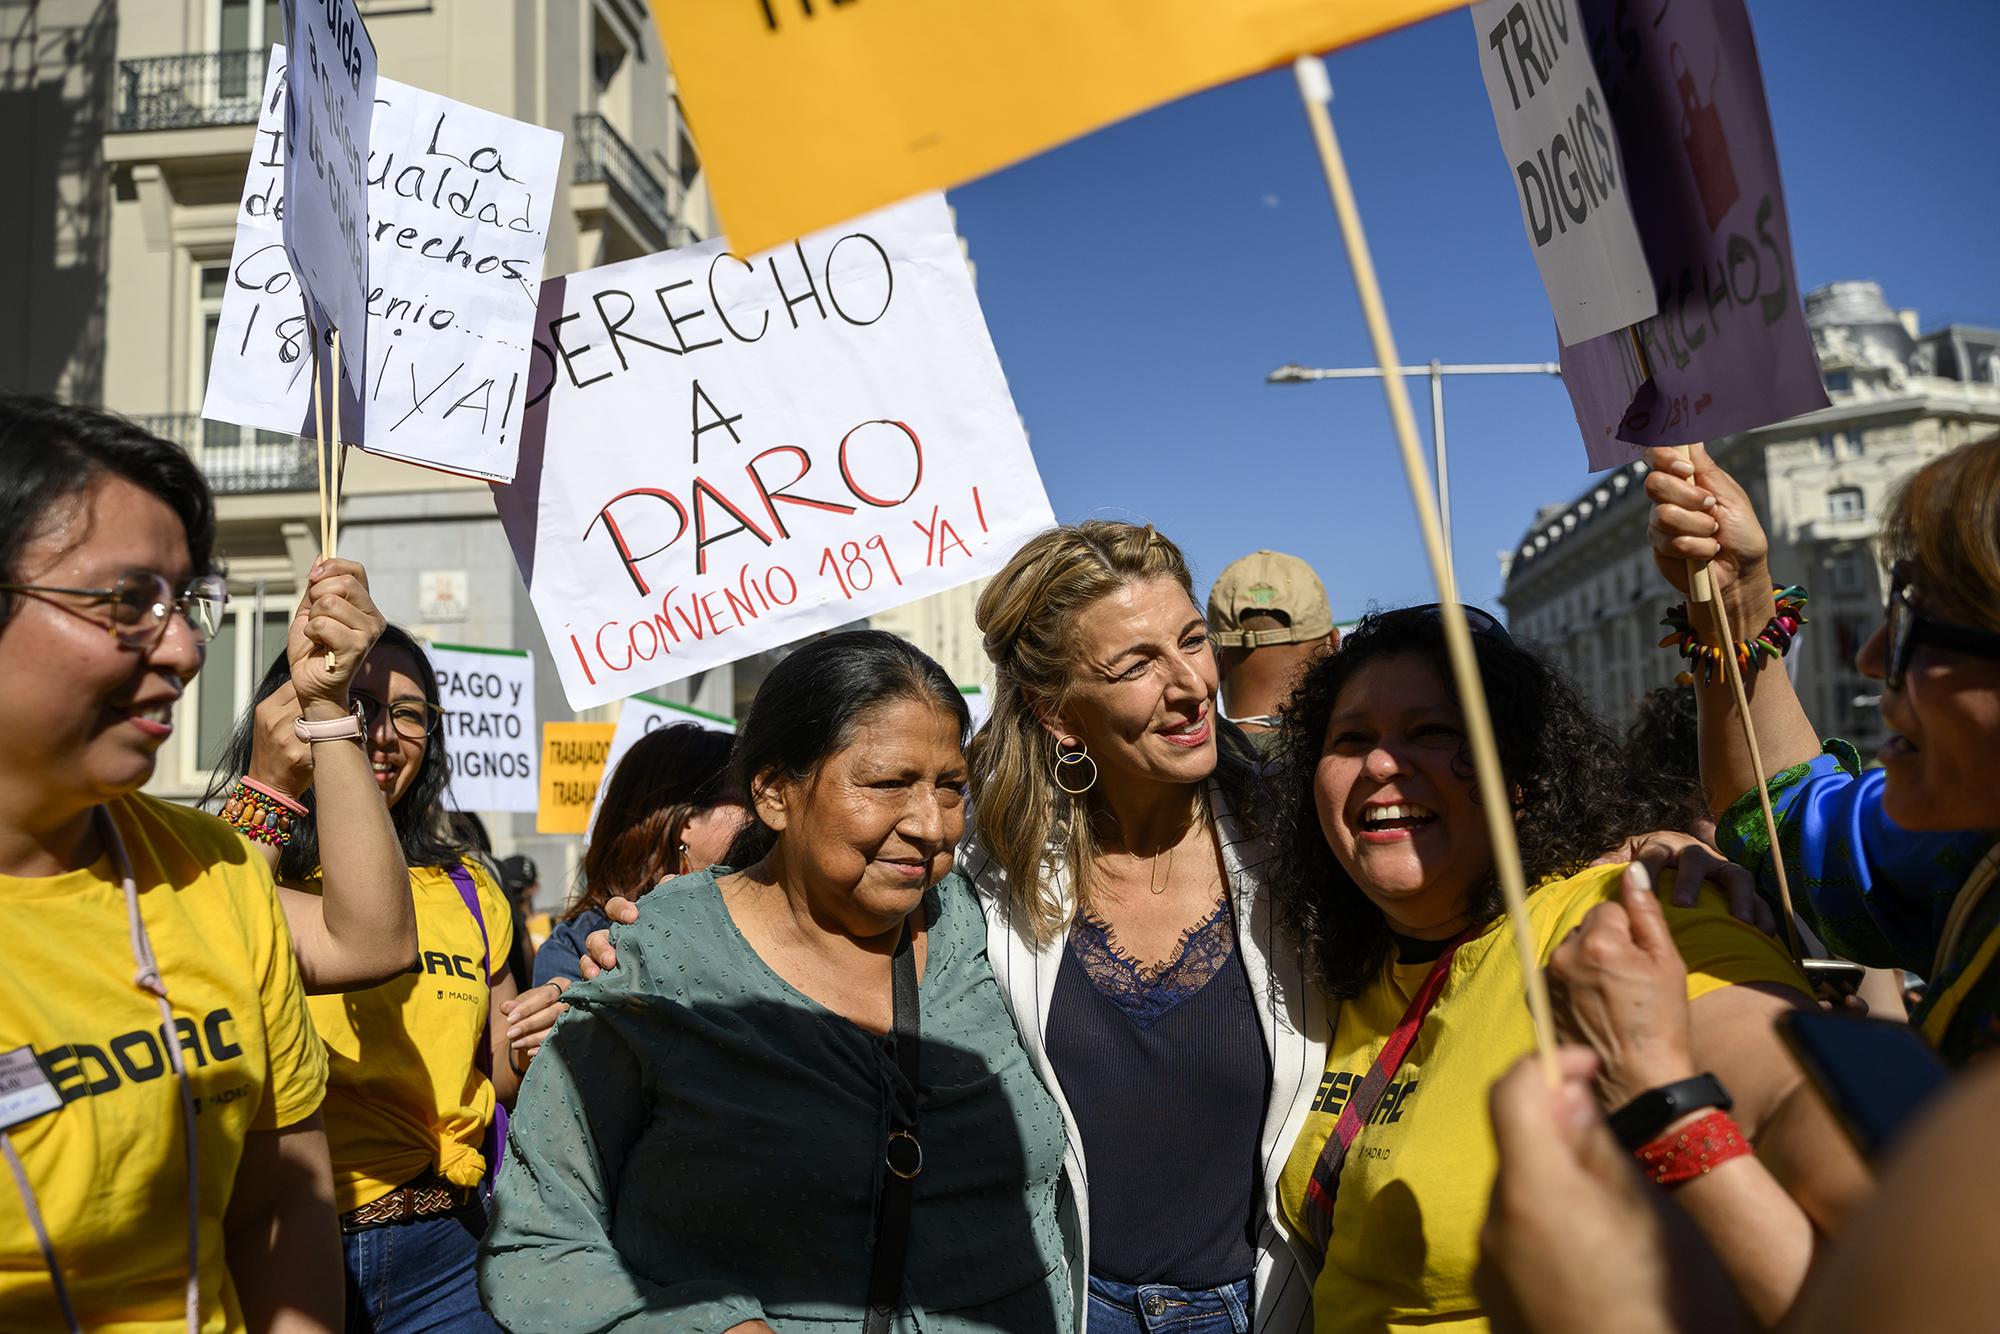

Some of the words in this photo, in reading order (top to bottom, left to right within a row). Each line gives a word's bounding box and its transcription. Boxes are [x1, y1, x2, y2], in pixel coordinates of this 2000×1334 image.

[318, 0, 362, 101] uida
[426, 111, 526, 185] La
[1516, 86, 1617, 248] DIGNOS
[691, 379, 742, 464] A
[583, 419, 923, 597] PARO
[818, 534, 903, 600] 189
[444, 711, 521, 739] TRATO
[509, 681, 522, 707] y
[448, 991, 479, 1005] MADRID
[36, 1008, 243, 1102] EDOAC
